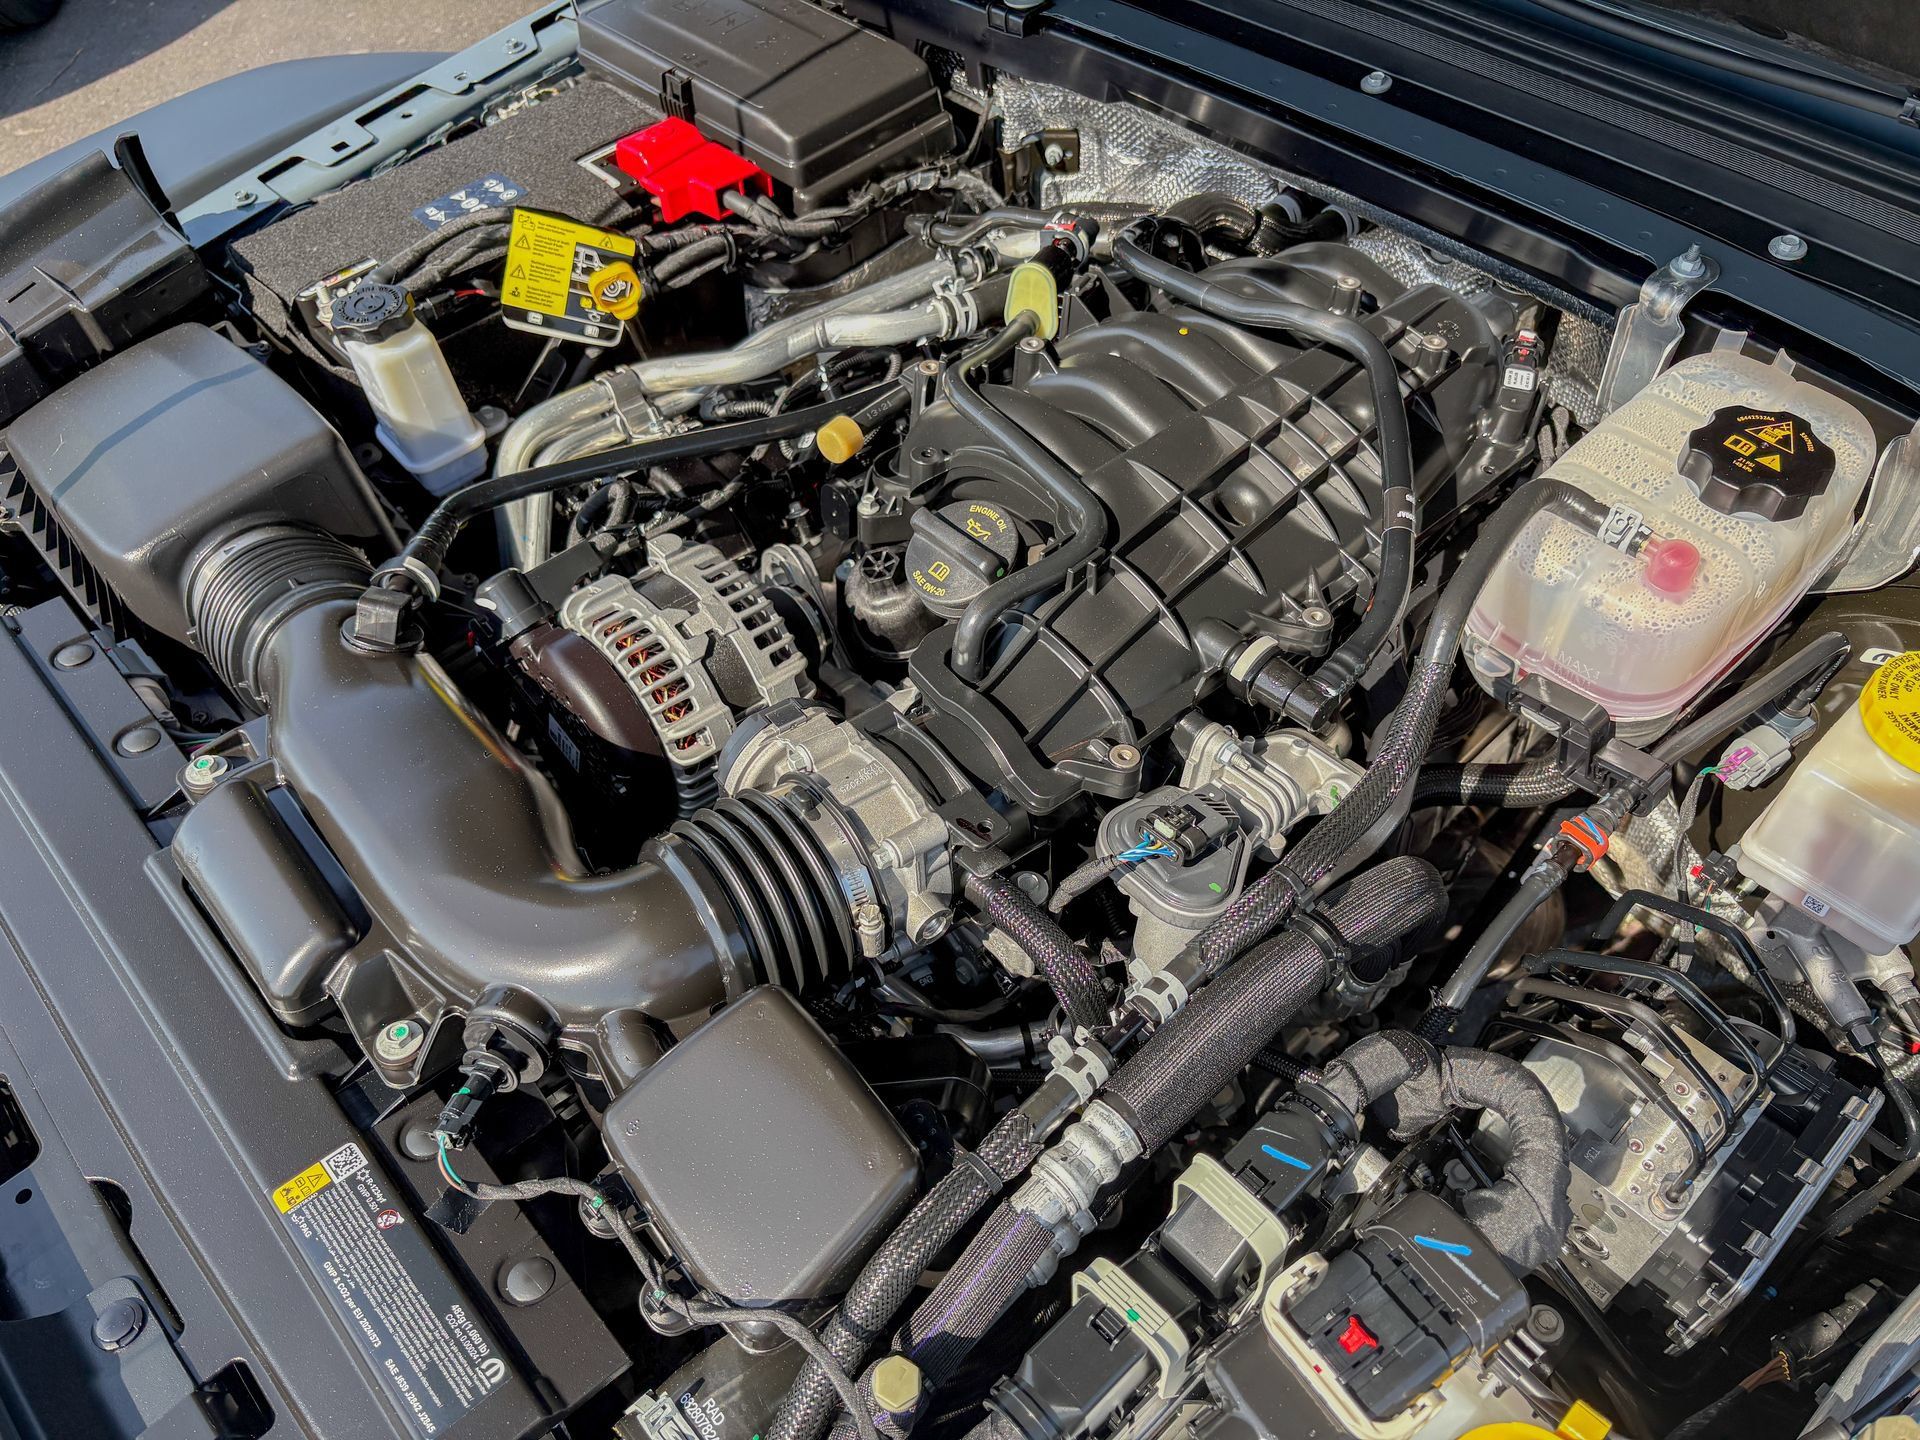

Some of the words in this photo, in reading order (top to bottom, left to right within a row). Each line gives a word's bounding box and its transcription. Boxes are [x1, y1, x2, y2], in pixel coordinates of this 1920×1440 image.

[969, 504, 1000, 522] ENGINE
[996, 518, 1008, 533] OIL
[912, 570, 926, 587] SAE
[922, 581, 946, 597] 0W-20
[1888, 653, 1914, 670] SEALED
[1876, 667, 1894, 701] CONTAINER.
[1889, 680, 1901, 701] ONLY
[1895, 670, 1908, 684] USE
[1904, 676, 1916, 693] CAP
[356, 1183, 371, 1198] GWP
[366, 1196, 380, 1212] 0.501
[364, 1177, 387, 1203] R-1234yf
[299, 1222, 313, 1239] PAG
[323, 1260, 337, 1277] GWP
[335, 1281, 350, 1299] CO2
[344, 1297, 356, 1310] per
[352, 1307, 363, 1319] EU
[358, 1316, 382, 1348] 2024/573
[445, 1313, 458, 1328] CO2
[454, 1327, 462, 1338] eq
[460, 1334, 479, 1359] 0.00024
[450, 1303, 467, 1324] 482g
[461, 1320, 482, 1344] (1.060
[477, 1342, 489, 1356] lb)
[384, 1357, 399, 1376] SAE
[394, 1374, 409, 1392] J639
[404, 1390, 423, 1413] J2842
[417, 1410, 436, 1433] J2845
[702, 1396, 726, 1427] RAD
